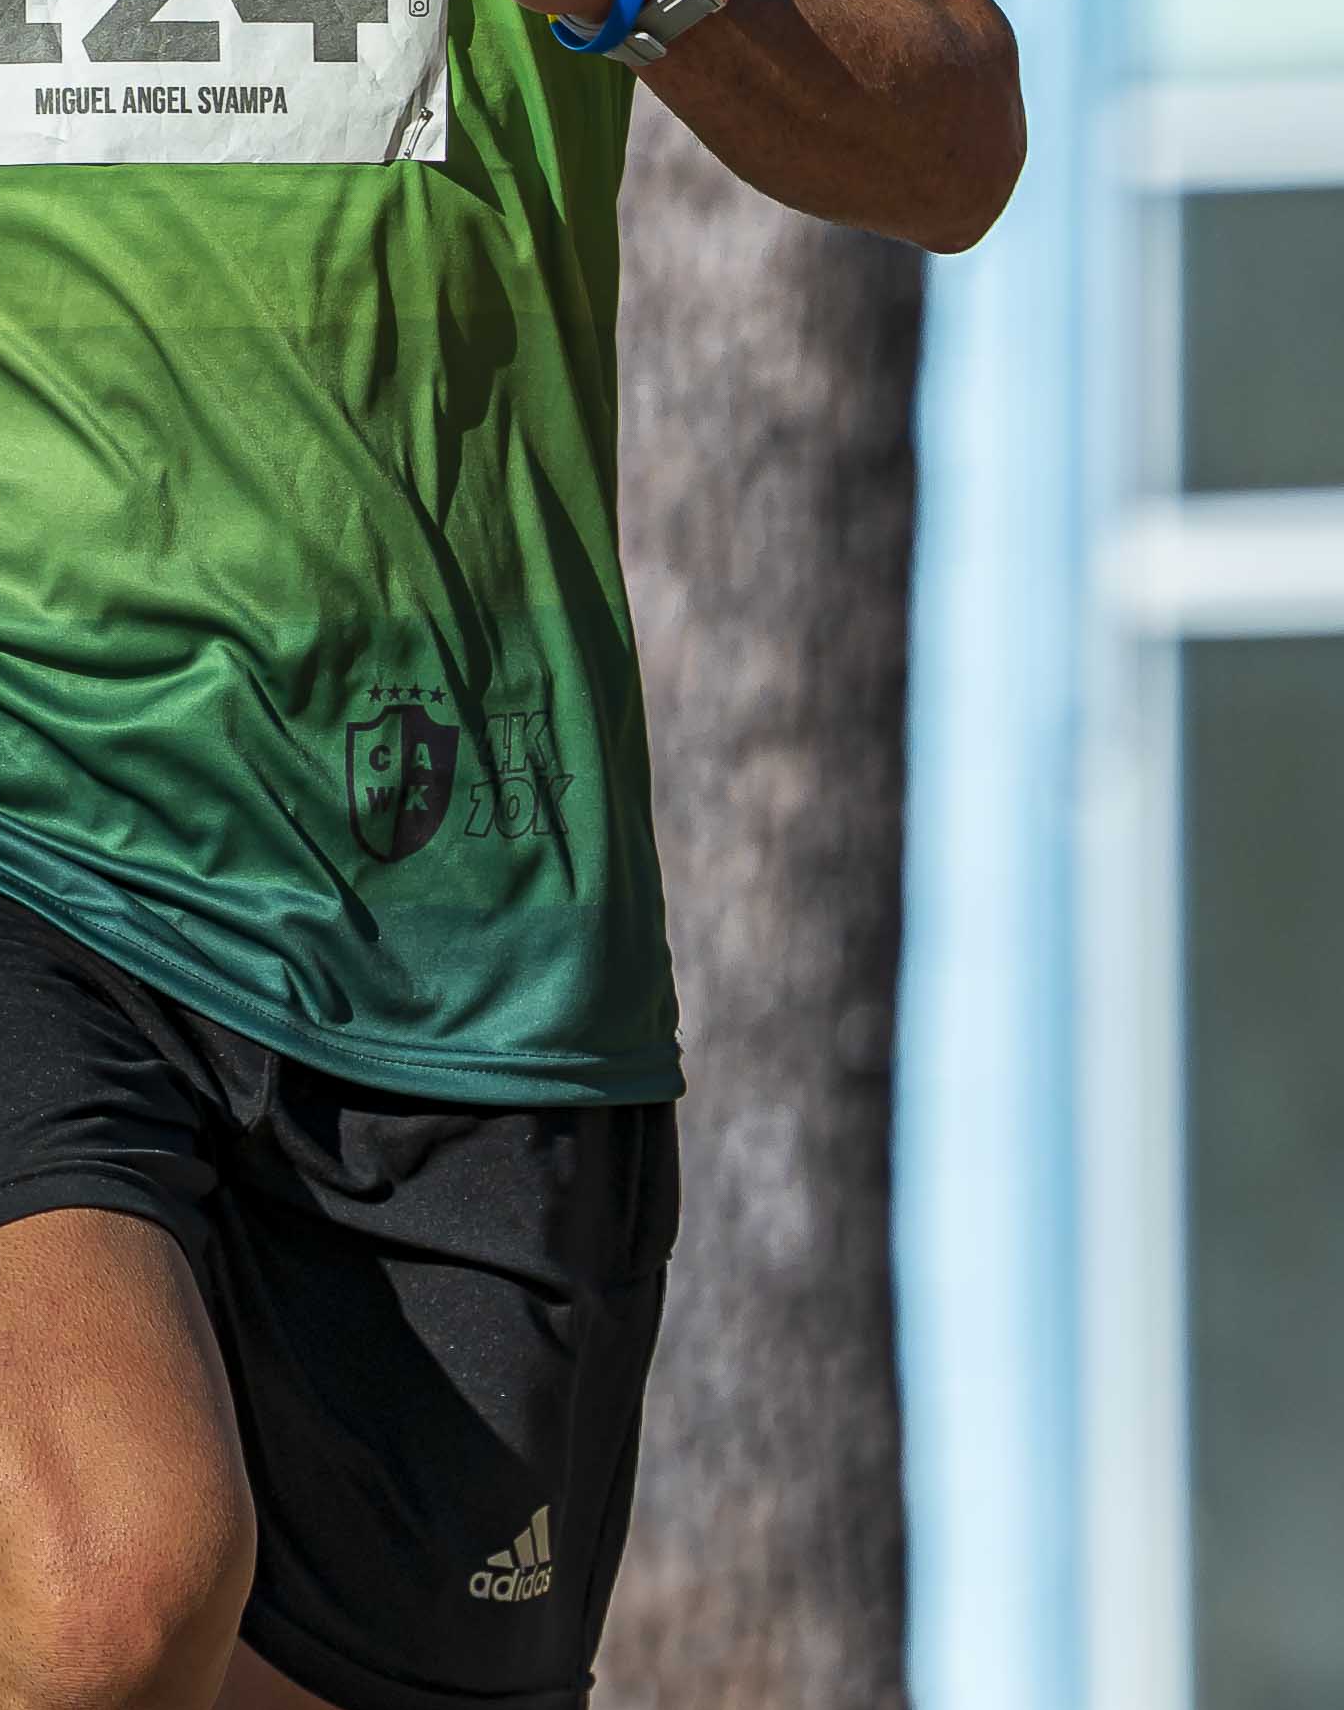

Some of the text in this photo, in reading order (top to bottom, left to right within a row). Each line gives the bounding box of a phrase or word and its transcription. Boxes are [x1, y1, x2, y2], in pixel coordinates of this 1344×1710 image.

[35, 86, 288, 114] MIGUEL ANGEL SVAMPA
[469, 1565, 552, 1602] adidas
